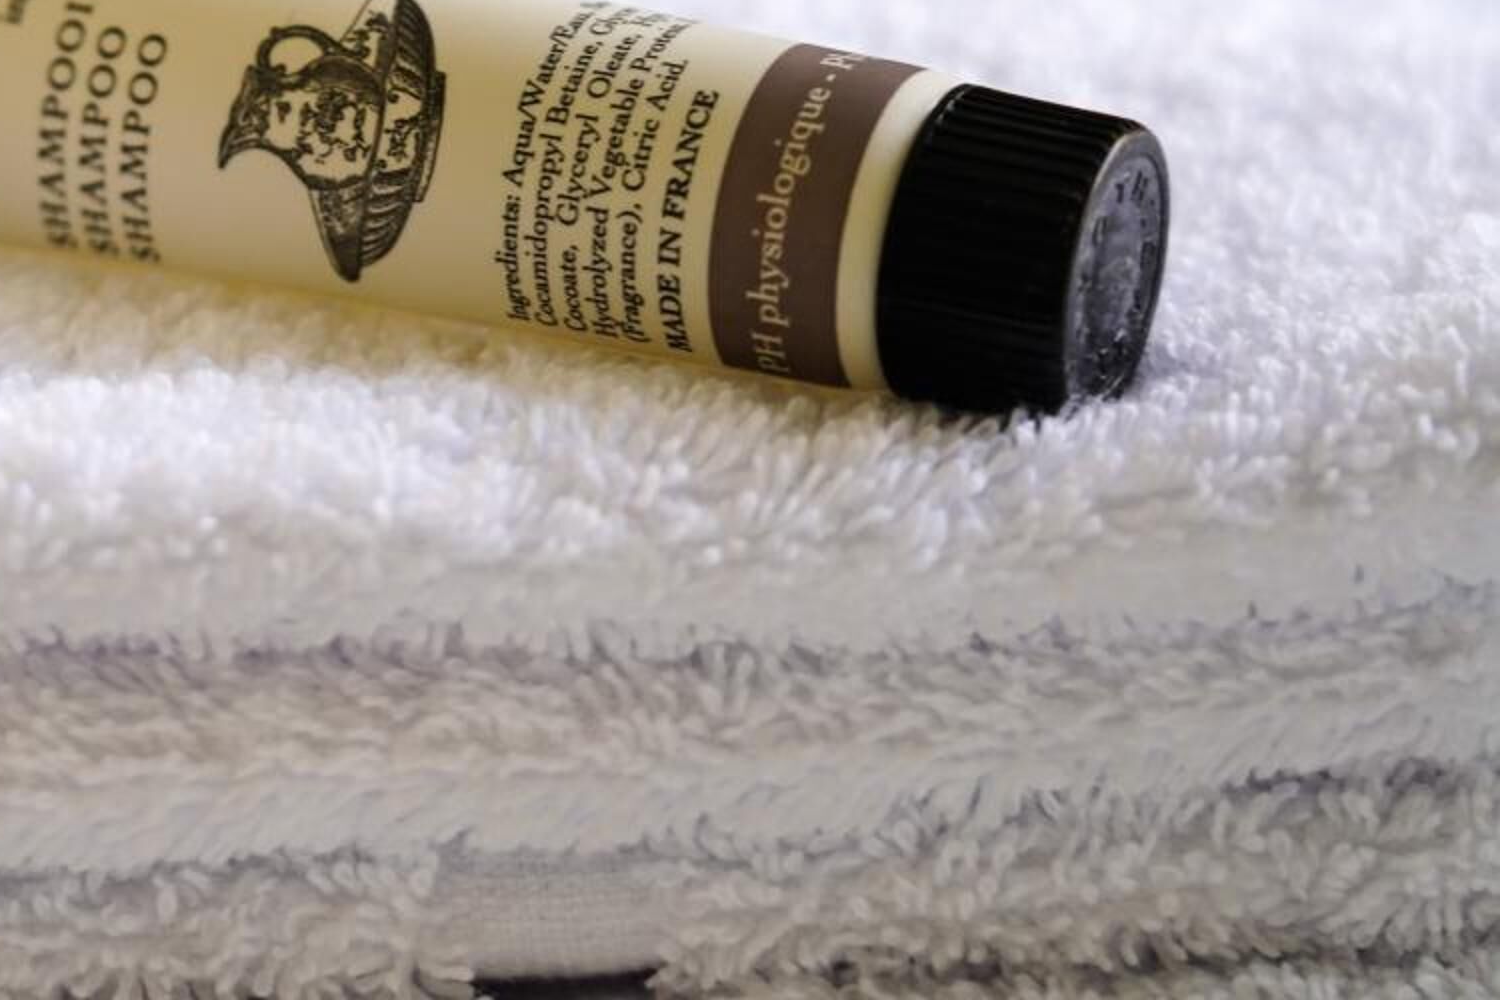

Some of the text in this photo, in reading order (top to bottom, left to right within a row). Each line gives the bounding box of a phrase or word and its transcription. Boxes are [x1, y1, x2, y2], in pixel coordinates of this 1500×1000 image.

[586, 33, 643, 99] Oleate,
[645, 59, 689, 111] Acid.
[78, 26, 128, 260] SHAMPOO
[119, 33, 169, 264] SHAMPOO
[524, 131, 563, 327] Cocamidopropyl
[545, 40, 605, 127] Betaine,
[554, 113, 601, 227] Glyceryl
[588, 77, 646, 202] Vegetable
[621, 120, 660, 194] Citric
[495, 192, 531, 322] Ingredients:
[657, 89, 720, 354] MADE IN FRANCE
[746, 87, 832, 327] physiologique
[562, 244, 588, 333] Cocoate,
[583, 206, 620, 340] Hydrolyzed
[615, 203, 652, 344] (Fragrance),
[751, 330, 790, 373] pH
